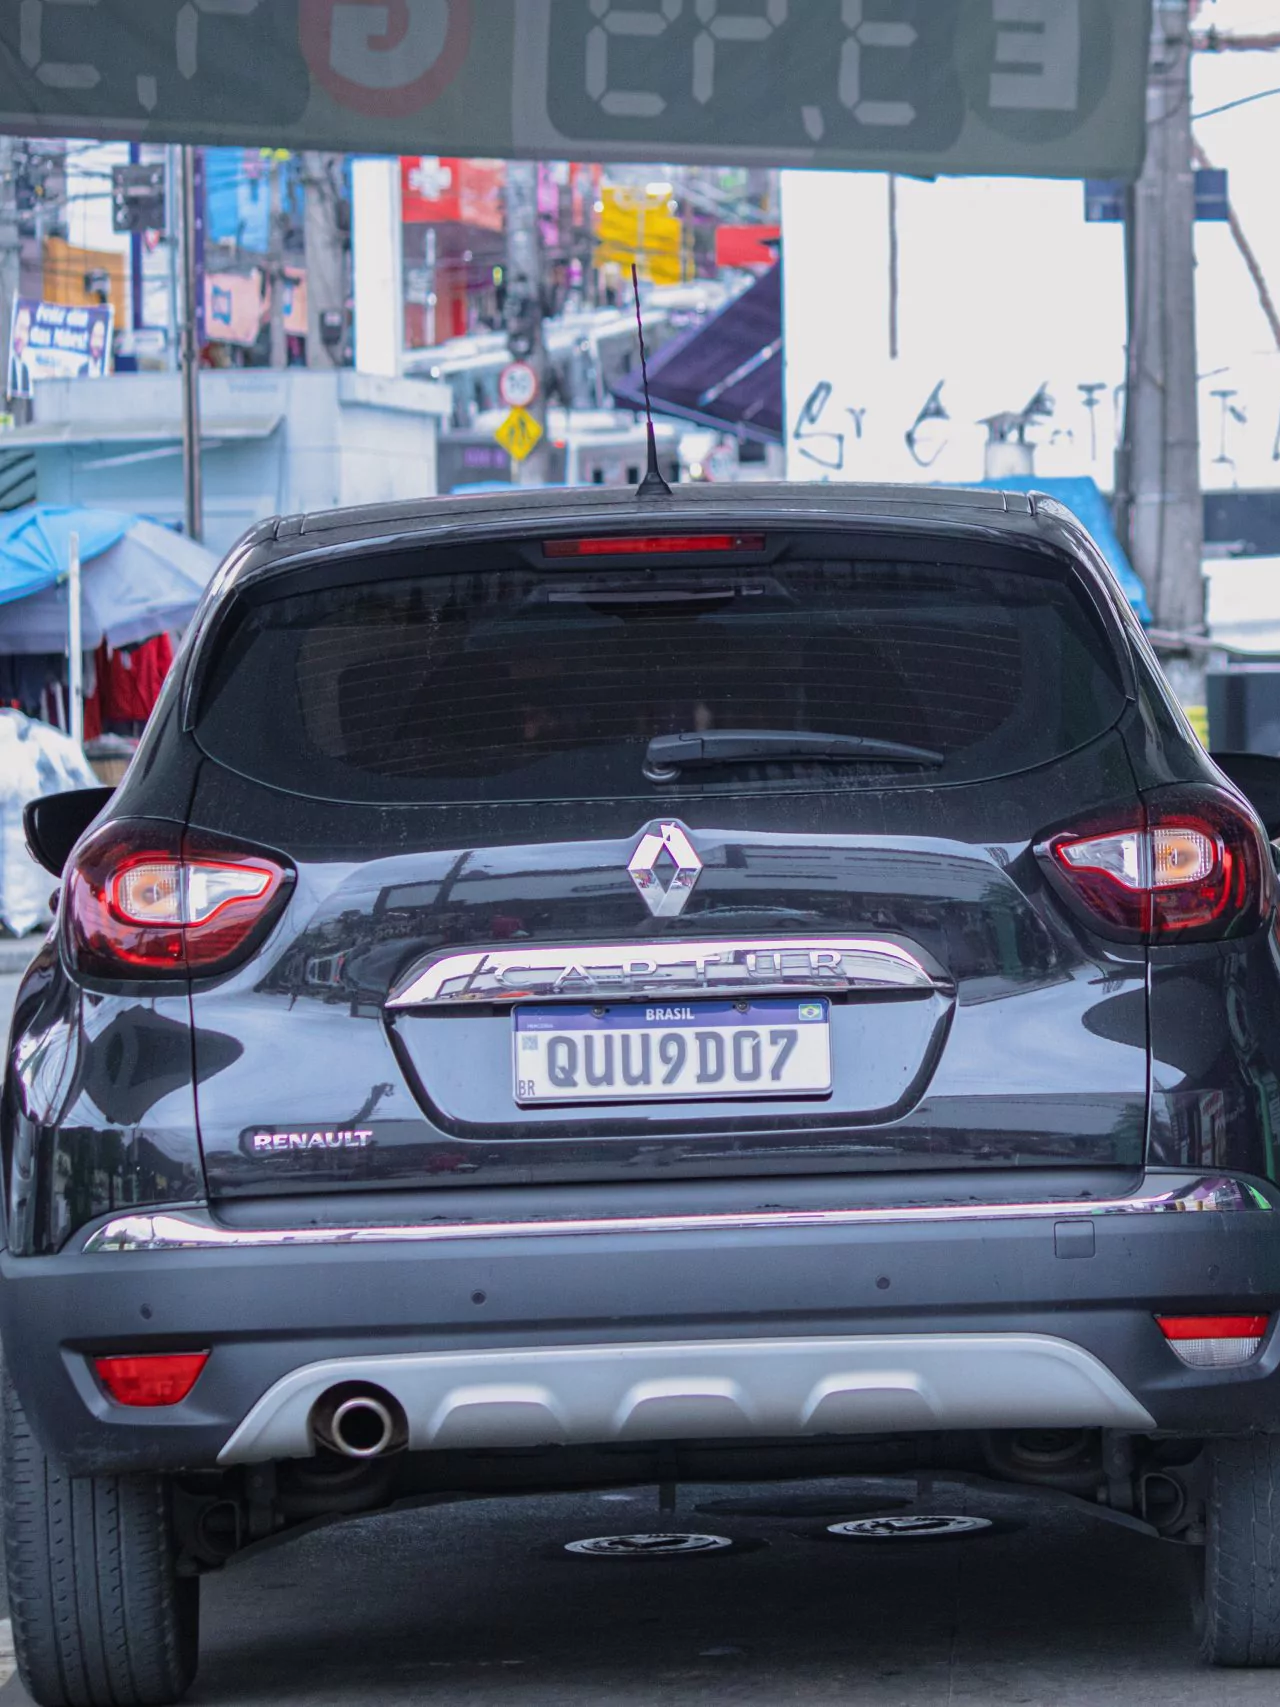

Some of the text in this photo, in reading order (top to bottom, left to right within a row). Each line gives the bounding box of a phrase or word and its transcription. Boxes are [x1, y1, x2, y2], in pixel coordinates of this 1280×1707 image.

[493, 951, 849, 990] CAPTUR
[645, 1007, 695, 1021] BRASIL
[546, 1028, 800, 1089] QUU9D07
[518, 1079, 536, 1096] BR
[253, 1130, 373, 1151] RENAULT
